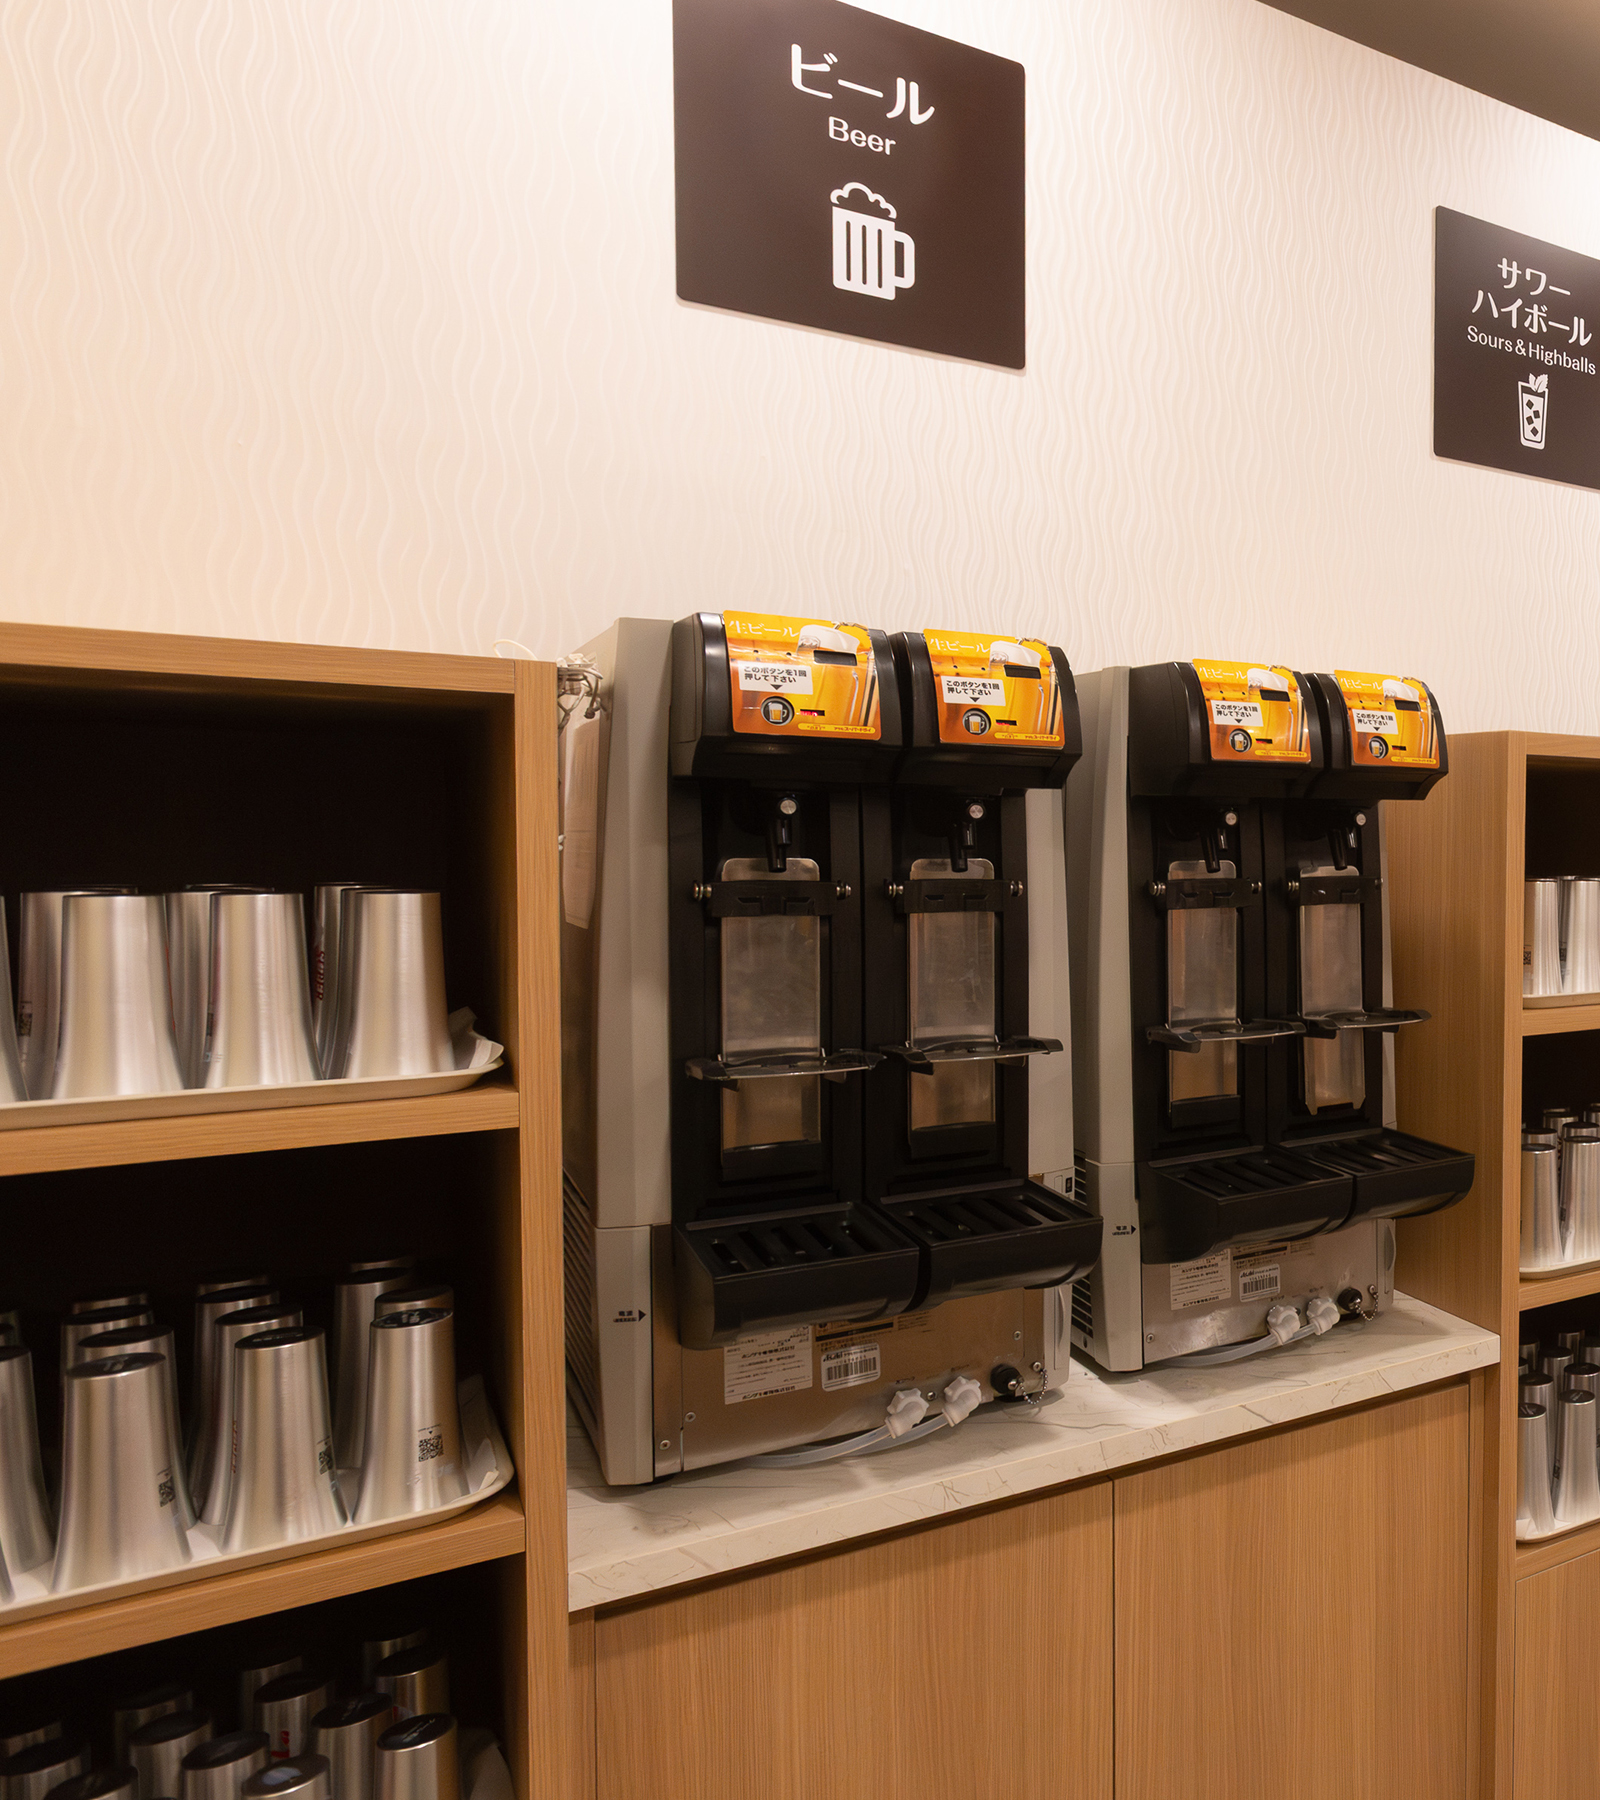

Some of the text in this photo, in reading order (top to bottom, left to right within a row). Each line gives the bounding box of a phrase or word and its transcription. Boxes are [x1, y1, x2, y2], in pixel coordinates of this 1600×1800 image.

[791, 43, 936, 126] ビール
[828, 115, 897, 156] Beer
[1497, 257, 1571, 297] サワー
[1471, 289, 1593, 347] ハイボール
[1467, 325, 1512, 354] Sours
[1529, 343, 1597, 376] Highballs
[728, 620, 800, 638] 生ビール
[930, 638, 991, 654] 生ビール
[743, 665, 807, 678] このボタンを1回
[744, 673, 797, 684] 押して下さい
[1199, 666, 1247, 680] 生ビール
[946, 680, 1000, 691] このボタンを1回
[947, 687, 992, 696] 押して下さい
[1340, 677, 1383, 690] 生ビール
